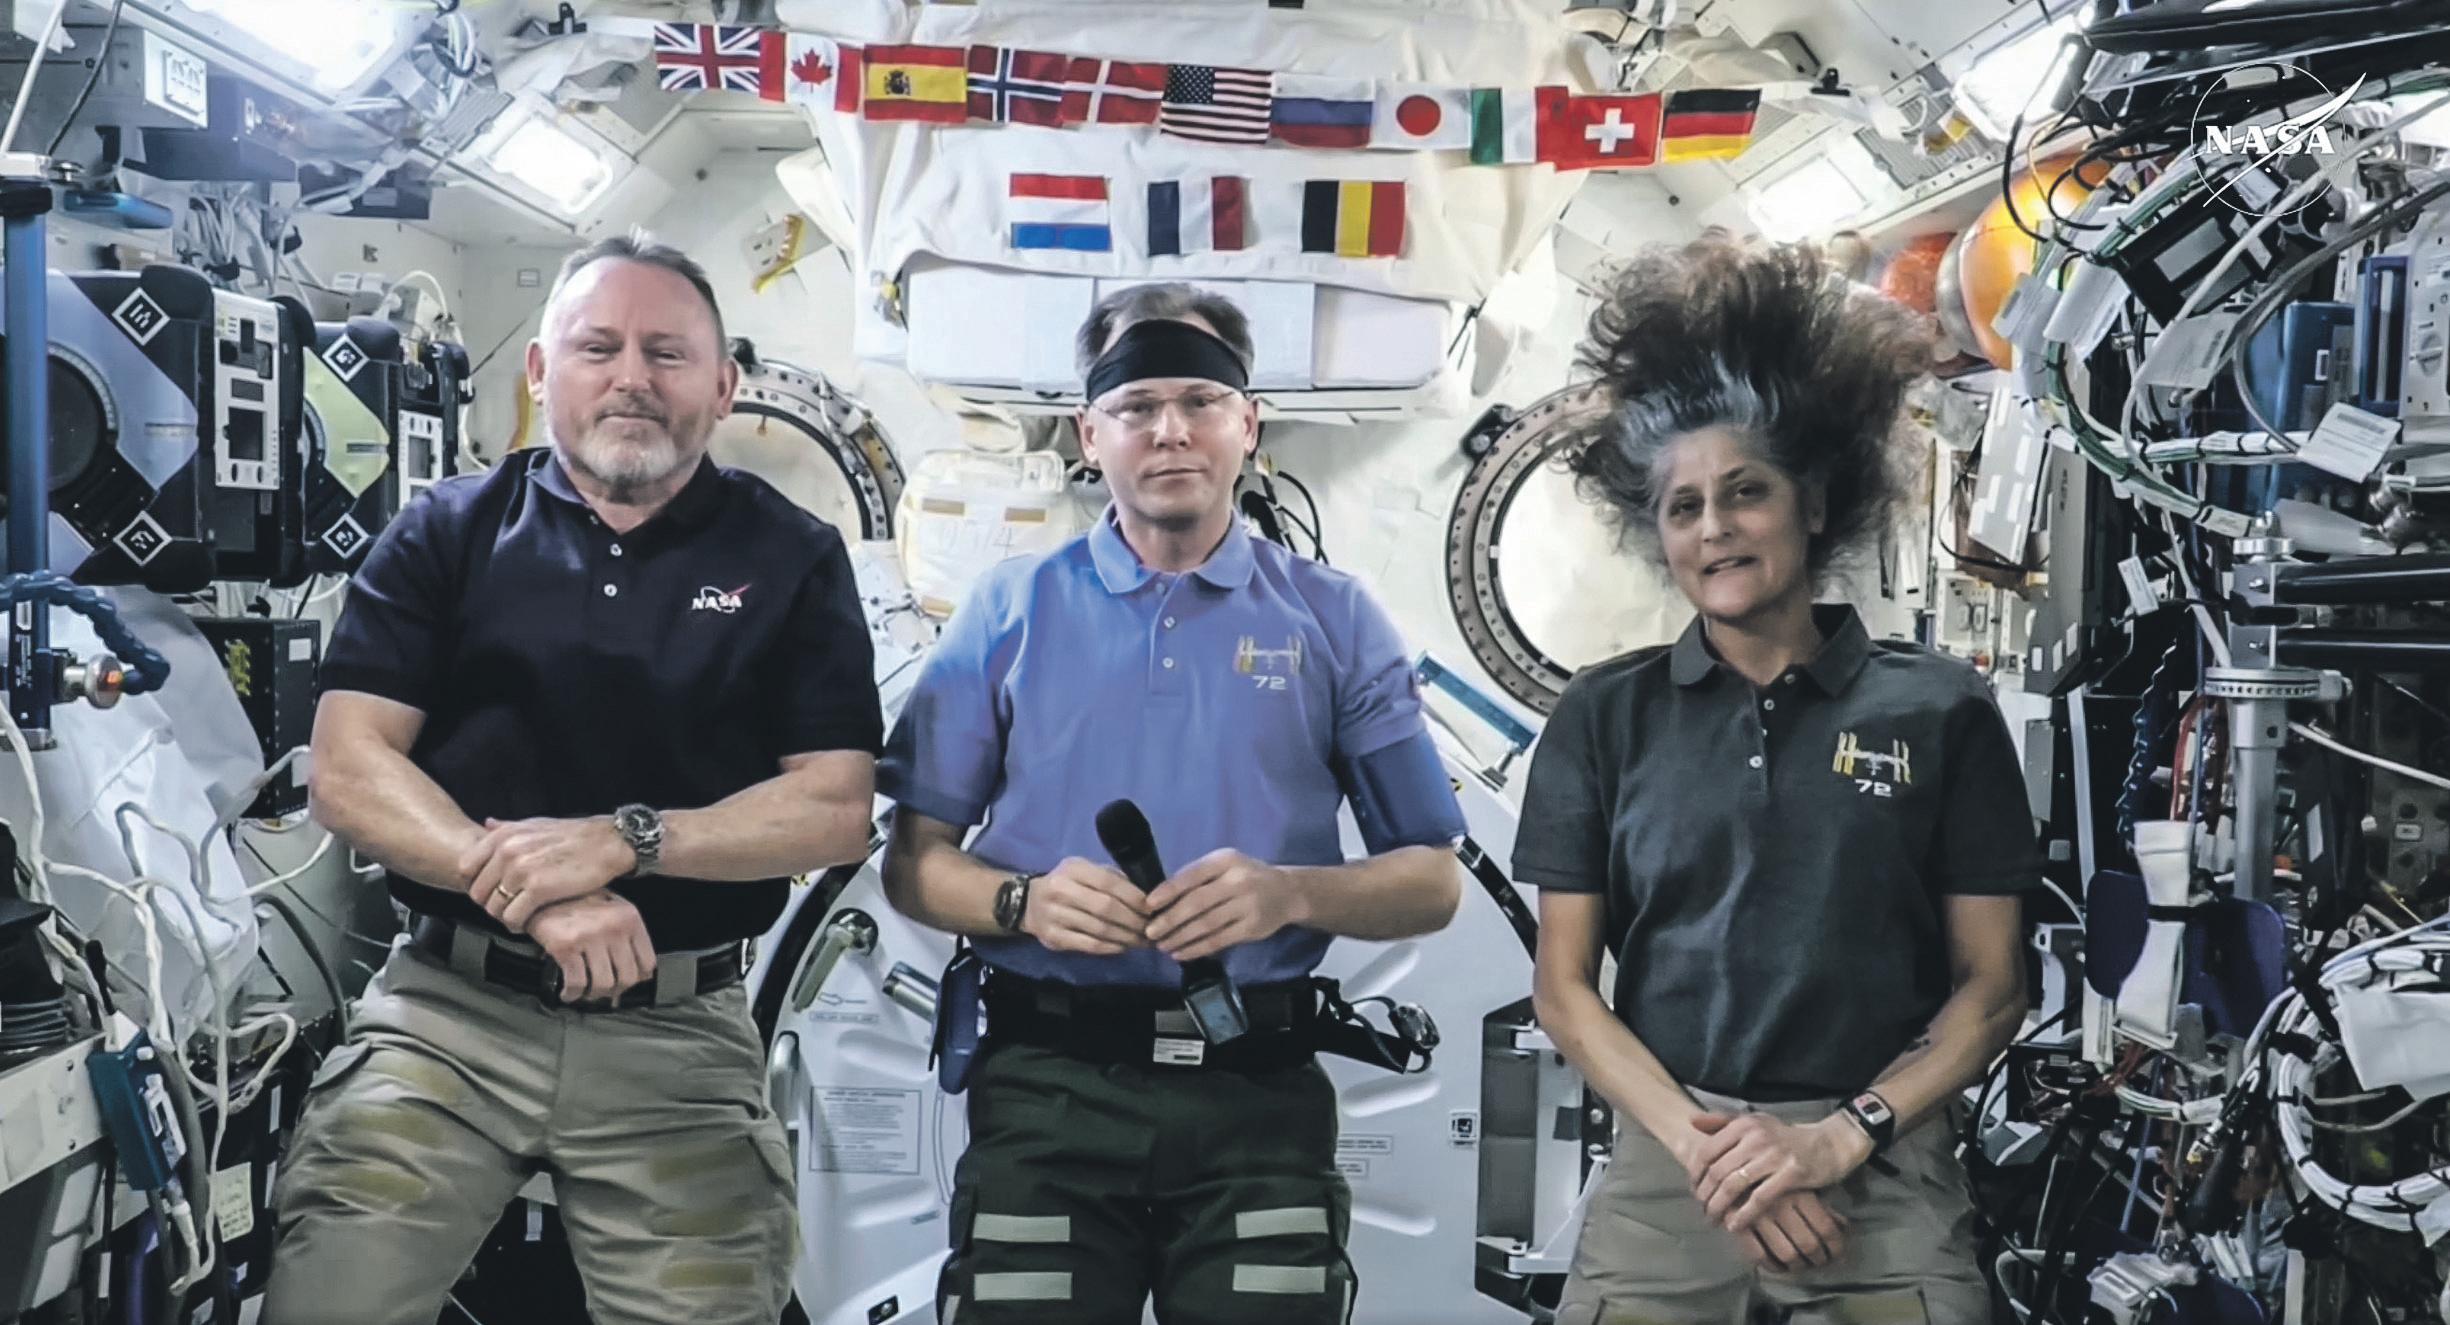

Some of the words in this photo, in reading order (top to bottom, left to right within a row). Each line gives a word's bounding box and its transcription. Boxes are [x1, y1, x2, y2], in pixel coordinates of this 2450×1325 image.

[691, 594, 743, 611] NASA
[1251, 675, 1287, 690] 72
[1855, 778, 1893, 798] 72
